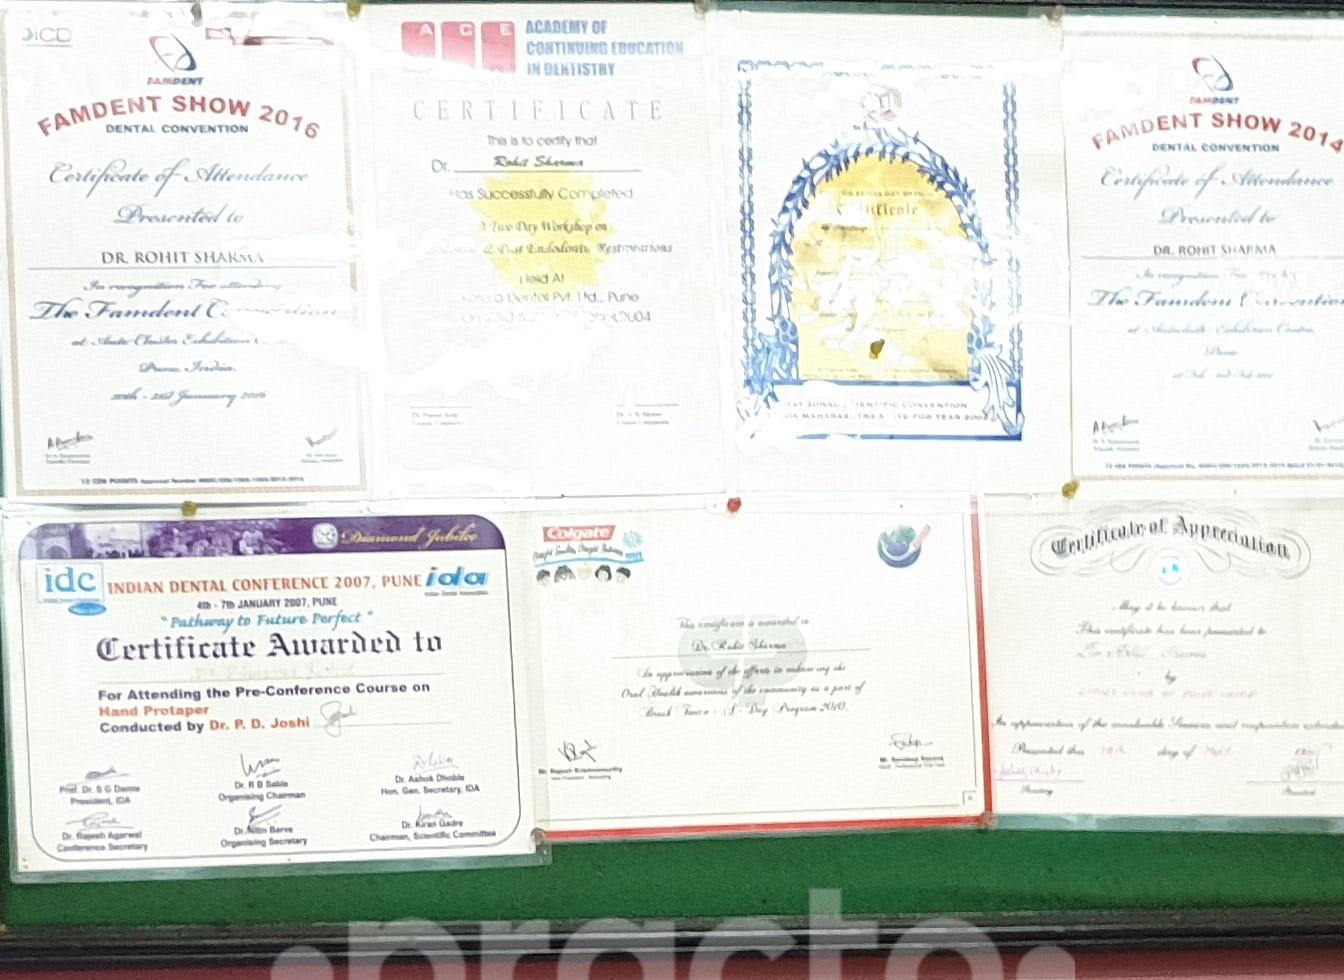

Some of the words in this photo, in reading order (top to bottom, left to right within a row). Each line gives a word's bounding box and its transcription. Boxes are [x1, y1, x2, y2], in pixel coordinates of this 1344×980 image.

[526, 20, 590, 34] ACADEMY
[594, 21, 607, 34] OF
[526, 41, 607, 56] CONTINUING
[612, 41, 683, 56] EDUCATION
[527, 63, 541, 76] IN
[545, 63, 615, 76] DENTISTRY
[147, 77, 204, 86] FAMDENT
[38, 95, 162, 136] FAMDENT
[172, 96, 250, 117] SHOW
[259, 106, 320, 139] 2016
[413, 100, 662, 120] CERTIFICATE
[106, 125, 156, 134] DENTAL
[162, 124, 248, 134] CONVENTION
[1092, 113, 1203, 150] FAMDENT
[1212, 112, 1281, 134] SHOW
[1288, 122, 1344, 153] 2014
[487, 135, 508, 146] This
[511, 135, 519, 146] is
[522, 136, 534, 146] to
[537, 135, 571, 148] certify
[575, 135, 597, 146] that
[1152, 144, 1197, 152] DENTAL
[1202, 143, 1280, 152] CONVENTION
[432, 160, 451, 172] Dr.
[50, 159, 148, 198] Certificate
[156, 158, 190, 198] of
[185, 163, 308, 183] Attendance
[477, 188, 554, 201] Successfully
[558, 188, 633, 201] Completed
[114, 204, 227, 225] Presented
[1154, 245, 1174, 256] DR.
[1179, 245, 1216, 256] ROHIT
[135, 252, 188, 264] ROHIT
[341, 527, 422, 545] Diamond
[418, 523, 478, 549] Jubilee
[546, 527, 611, 541] Colgate
[1051, 521, 1145, 557] Certificate
[1148, 518, 1168, 534] of
[1174, 515, 1290, 559] Appreciation
[45, 567, 96, 593] idc
[426, 566, 489, 587] ida
[108, 580, 164, 595] INDIAN
[170, 580, 226, 593] DENTAL
[233, 576, 328, 592] CONFERENCE
[383, 574, 422, 587] PUNE
[197, 601, 211, 609] 4th
[222, 601, 235, 609] 7th
[238, 599, 280, 609] JANUARY
[313, 597, 337, 607] PUNE
[238, 616, 250, 626] to
[258, 613, 307, 626] Future
[96, 635, 256, 661] Certificate
[267, 631, 401, 657] Awarded
[414, 631, 442, 652] to
[98, 689, 121, 702] For
[127, 688, 202, 703] Attending
[207, 687, 230, 699] the
[235, 685, 350, 698] Pre-Conference
[356, 682, 407, 695] Course
[412, 683, 430, 693] on
[99, 706, 138, 717] Hand
[144, 704, 210, 718] Protaper
[100, 721, 181, 733] Conducted
[187, 720, 205, 735] by
[210, 719, 230, 731] Dr.
[235, 718, 246, 730] P.
[251, 718, 266, 730] D.
[271, 716, 310, 729] Joshi
